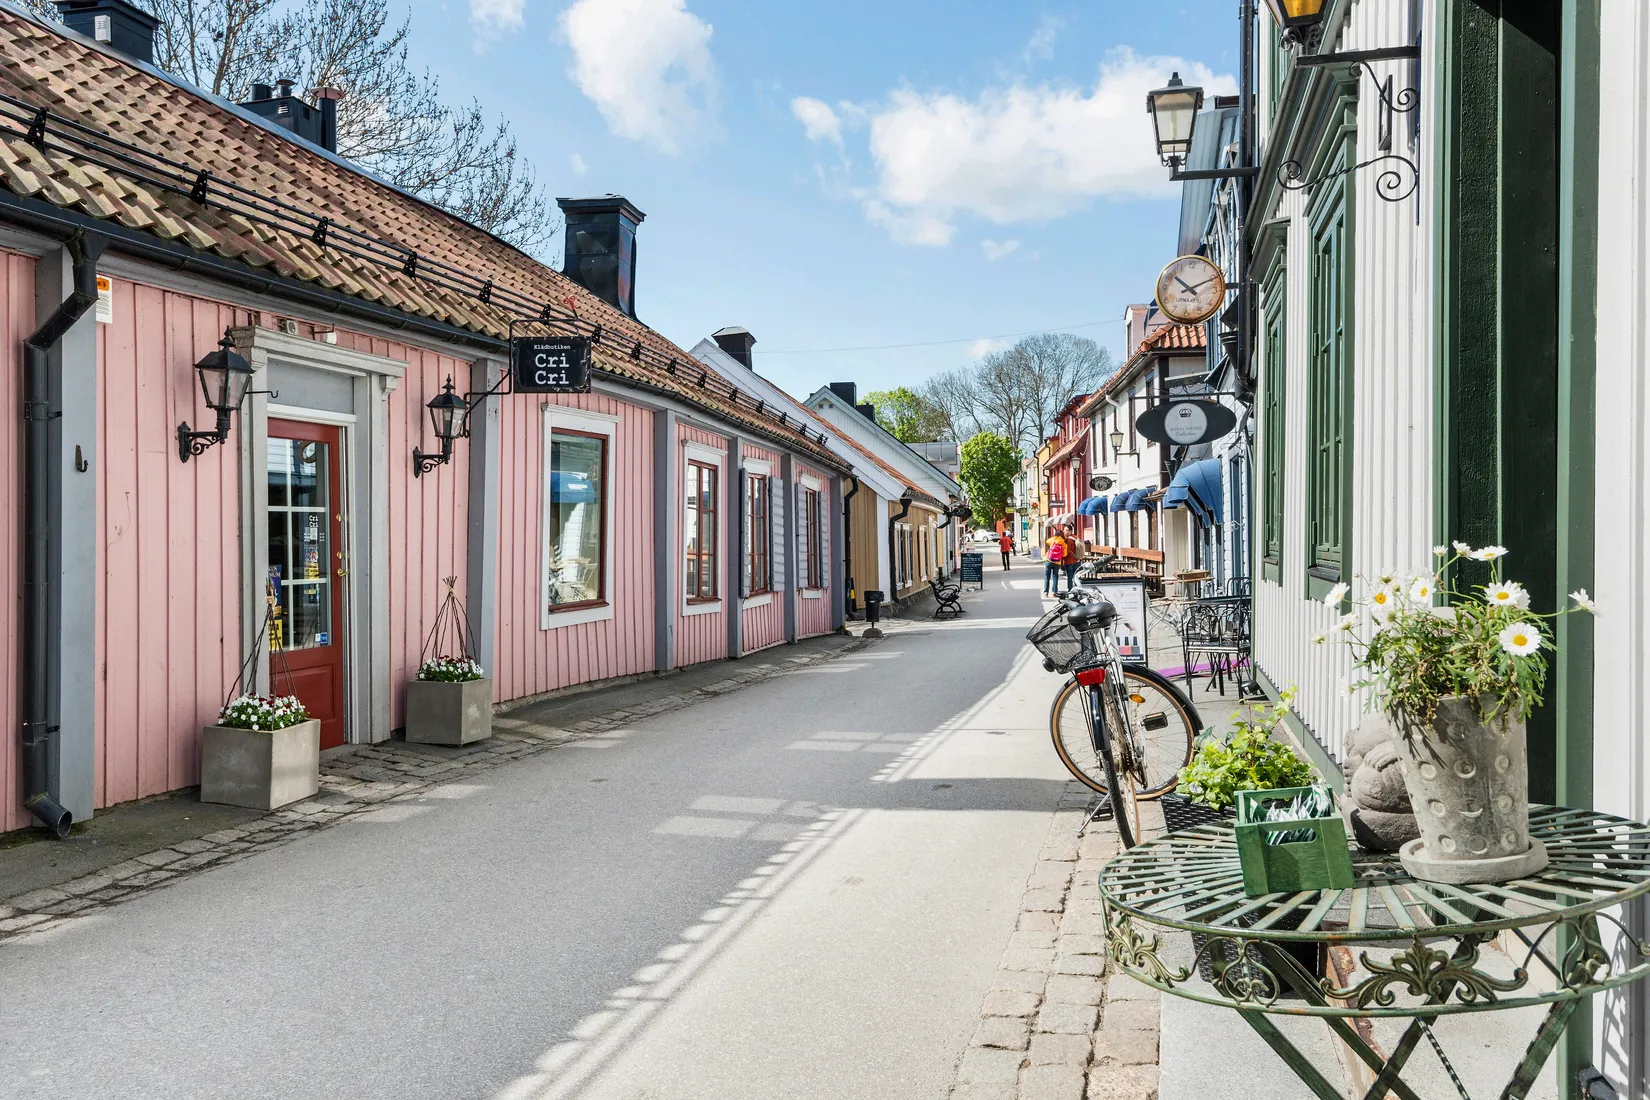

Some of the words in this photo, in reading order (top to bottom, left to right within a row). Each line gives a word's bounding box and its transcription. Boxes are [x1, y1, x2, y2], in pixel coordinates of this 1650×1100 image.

[1188, 261, 1196, 269] 12
[535, 353, 569, 368] Cri
[535, 370, 569, 385] Cri
